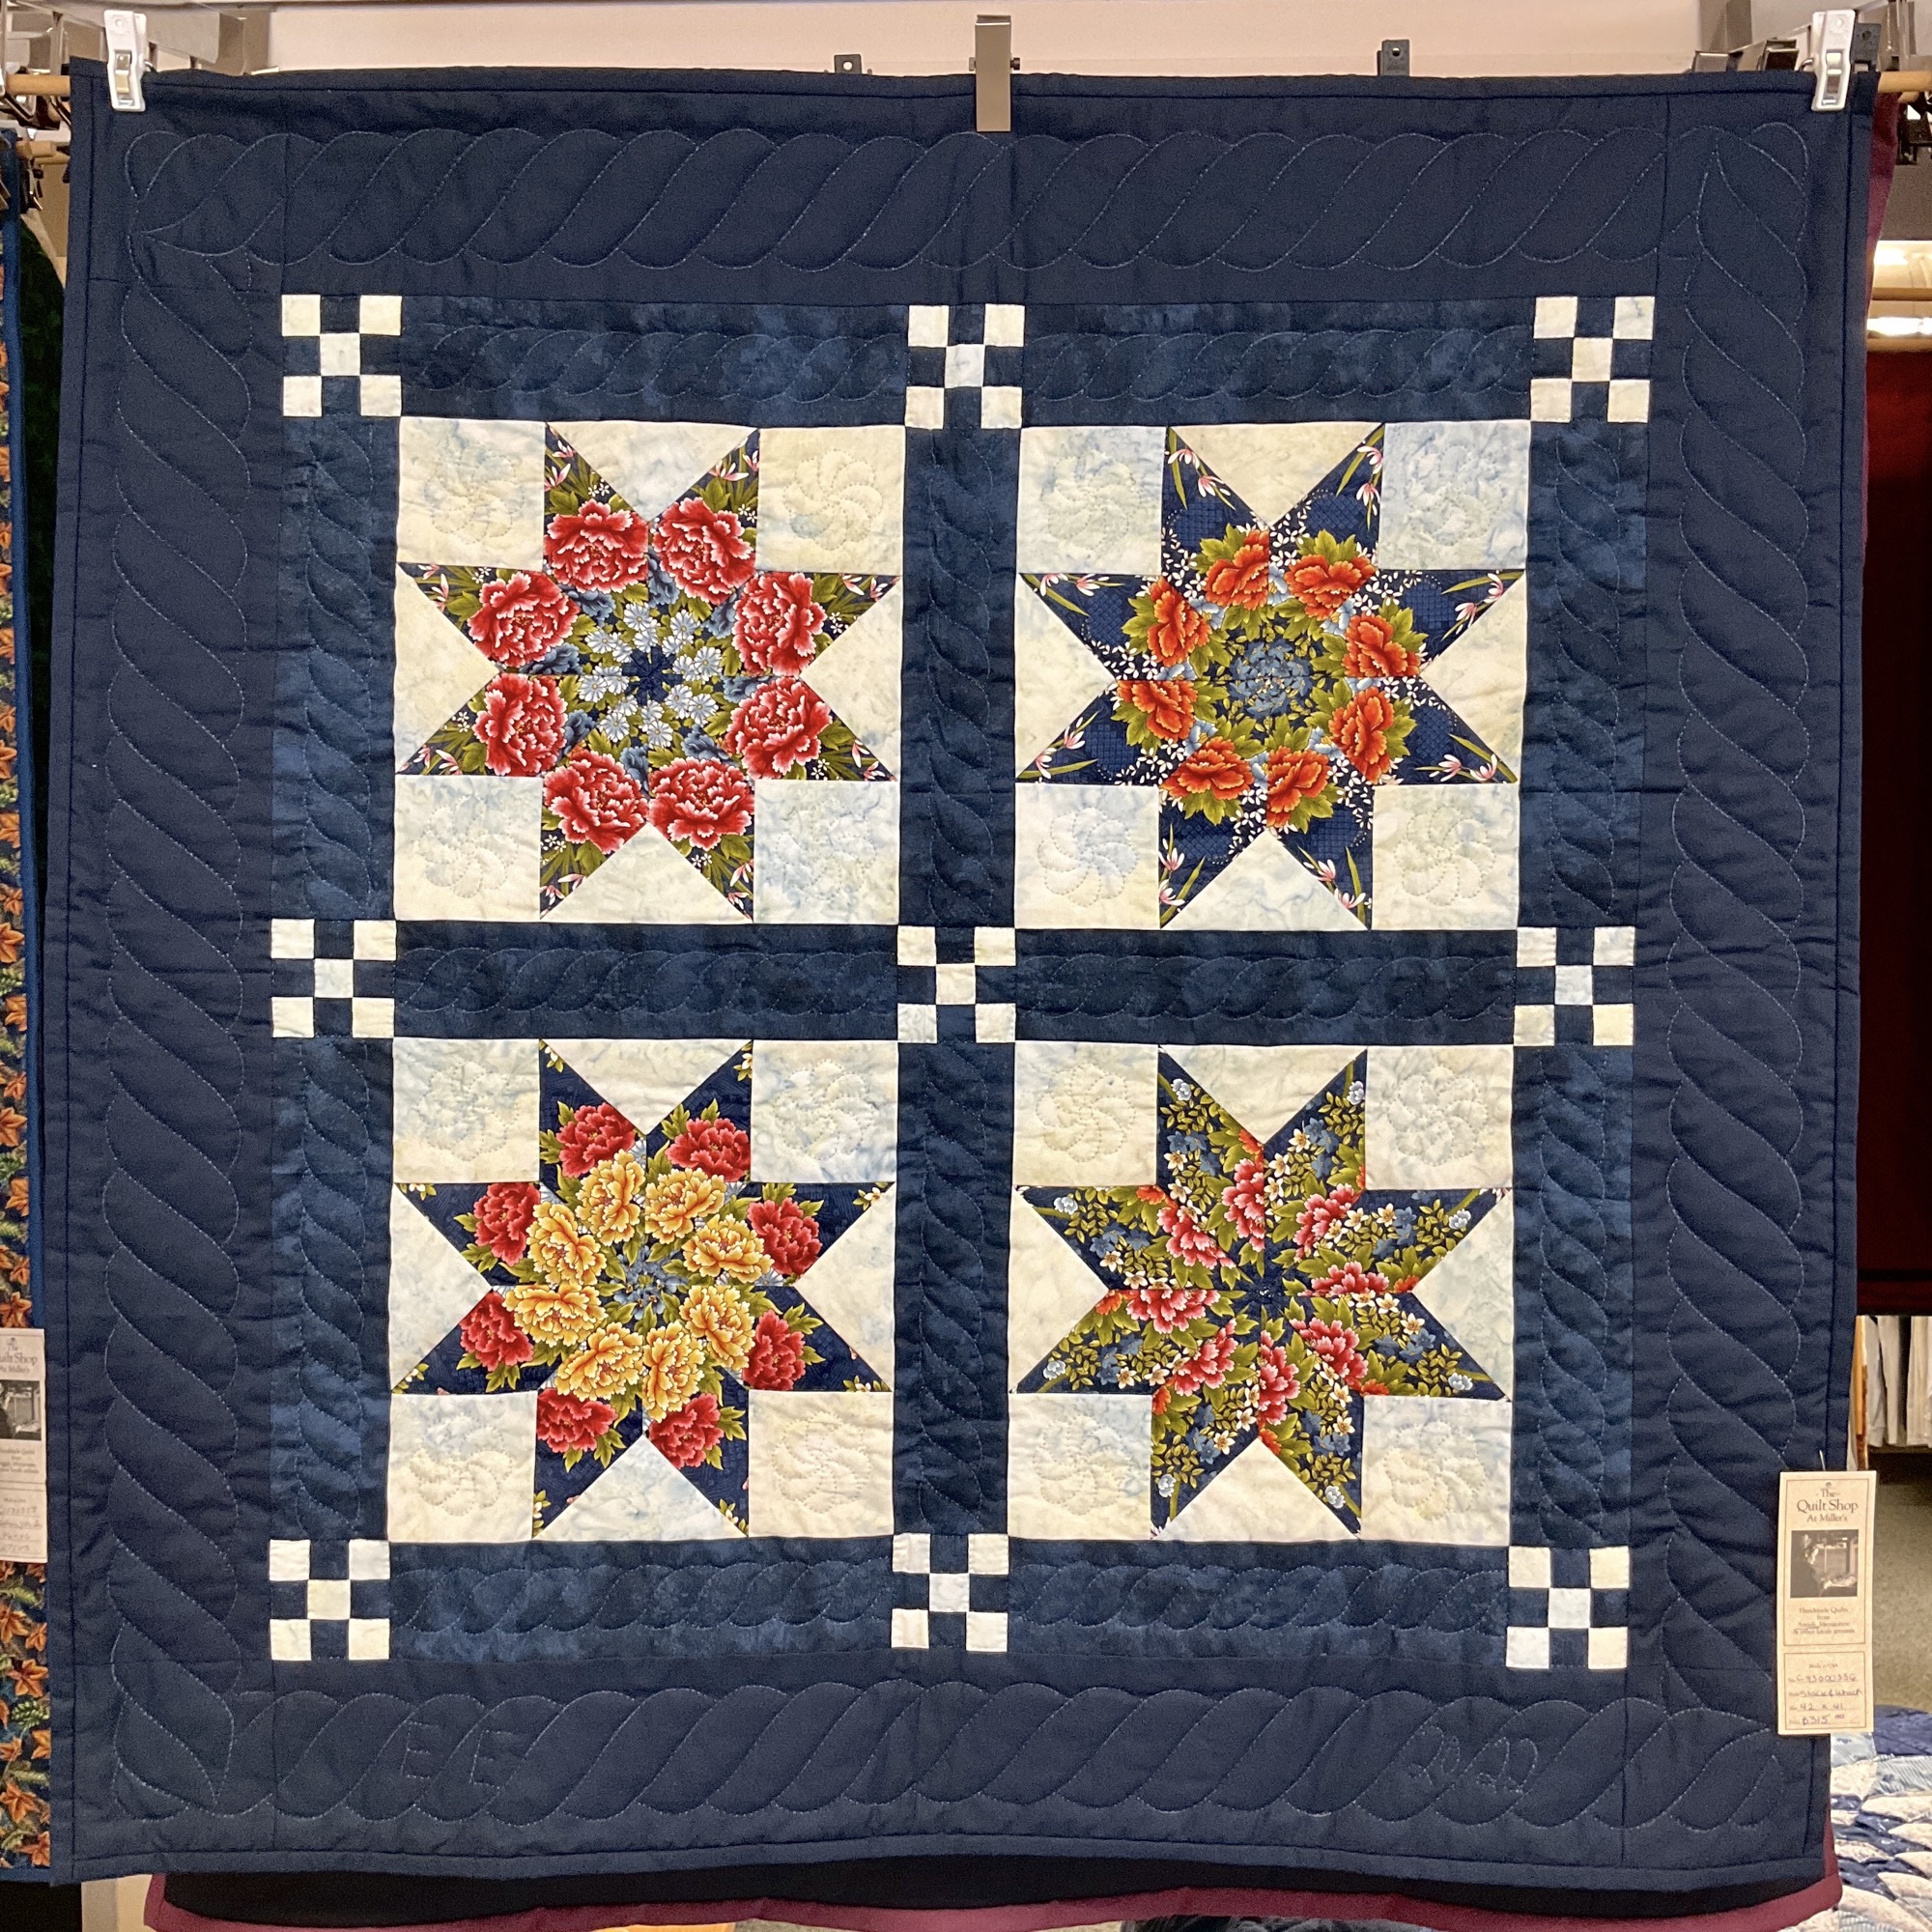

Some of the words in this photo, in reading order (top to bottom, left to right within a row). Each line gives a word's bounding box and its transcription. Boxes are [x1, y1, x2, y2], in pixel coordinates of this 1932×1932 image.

[1821, 1489, 1835, 1497] The
[1797, 1499, 1826, 1514] Quilt
[1829, 1499, 1858, 1514] Shop
[1806, 1514, 1817, 1522] At
[1819, 1514, 1847, 1522] Miller's
[1800, 1702, 1815, 1711] 42
